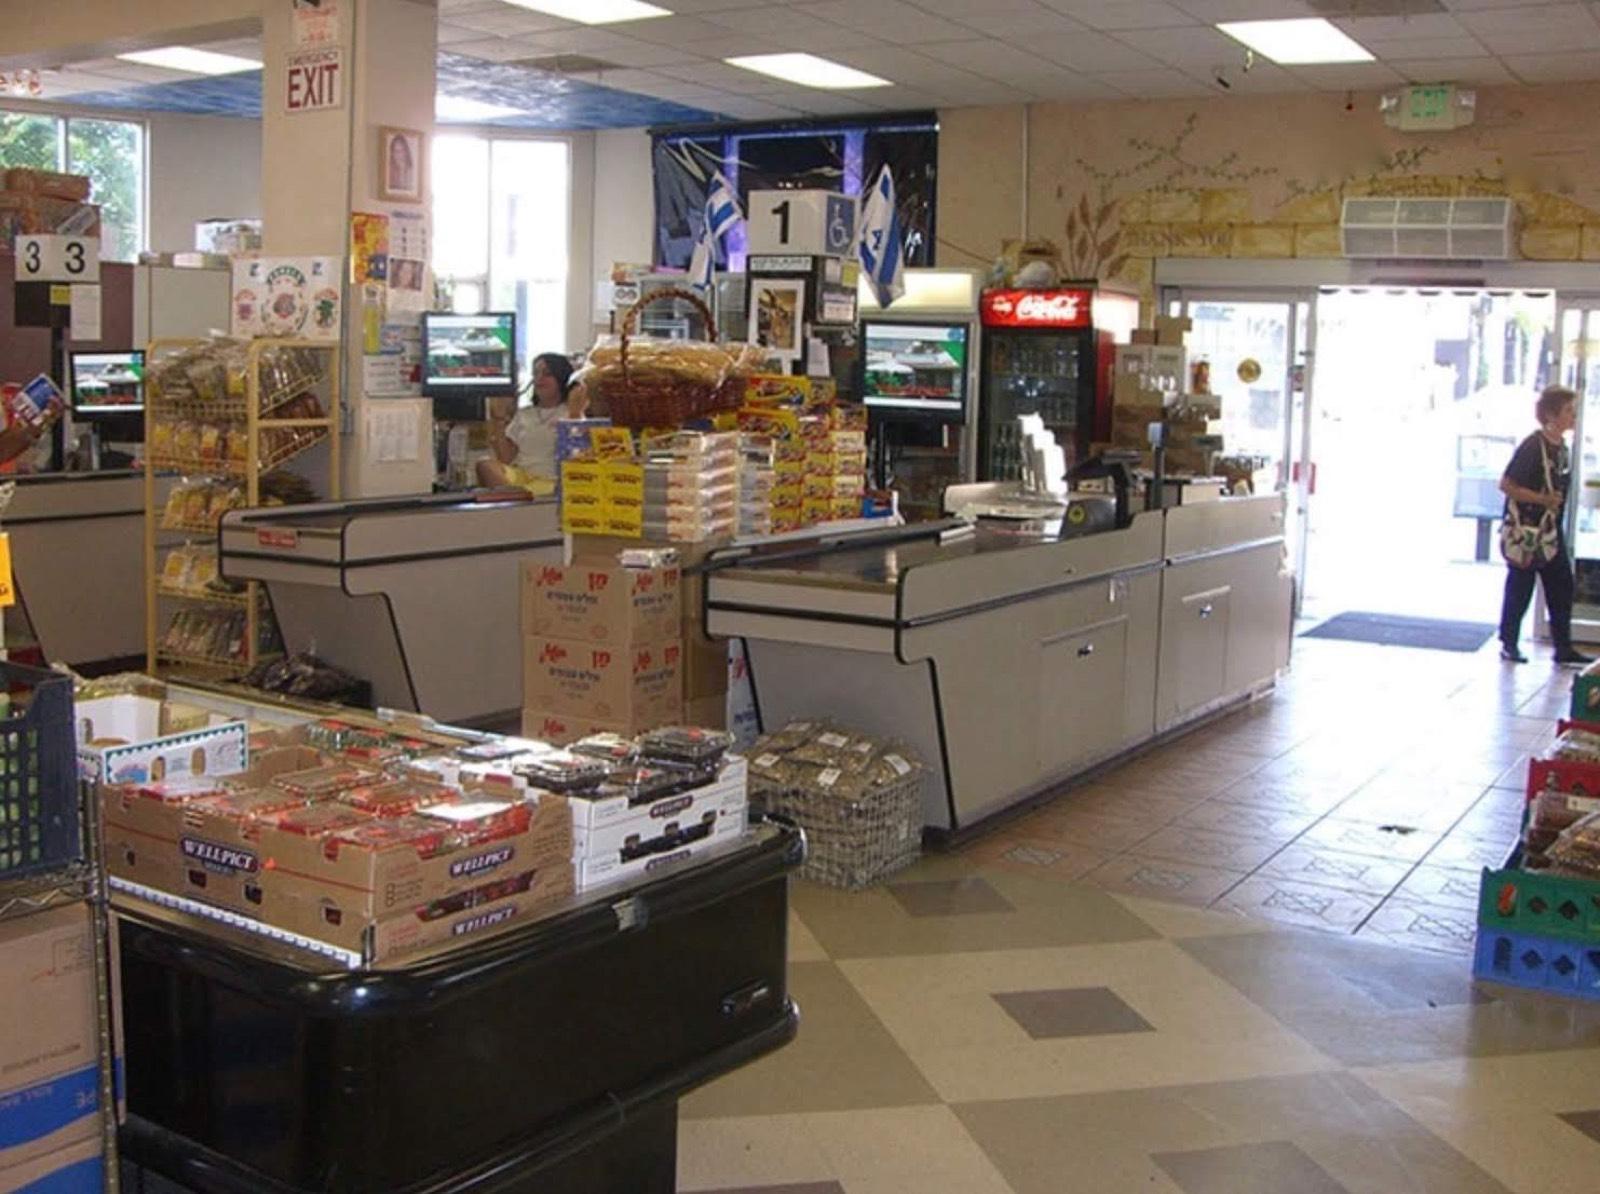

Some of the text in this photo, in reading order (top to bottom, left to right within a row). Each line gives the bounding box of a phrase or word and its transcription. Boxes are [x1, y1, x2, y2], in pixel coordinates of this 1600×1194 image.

[288, 64, 338, 108] EXIT
[771, 200, 789, 244] 1
[25, 240, 86, 274] 3 3
